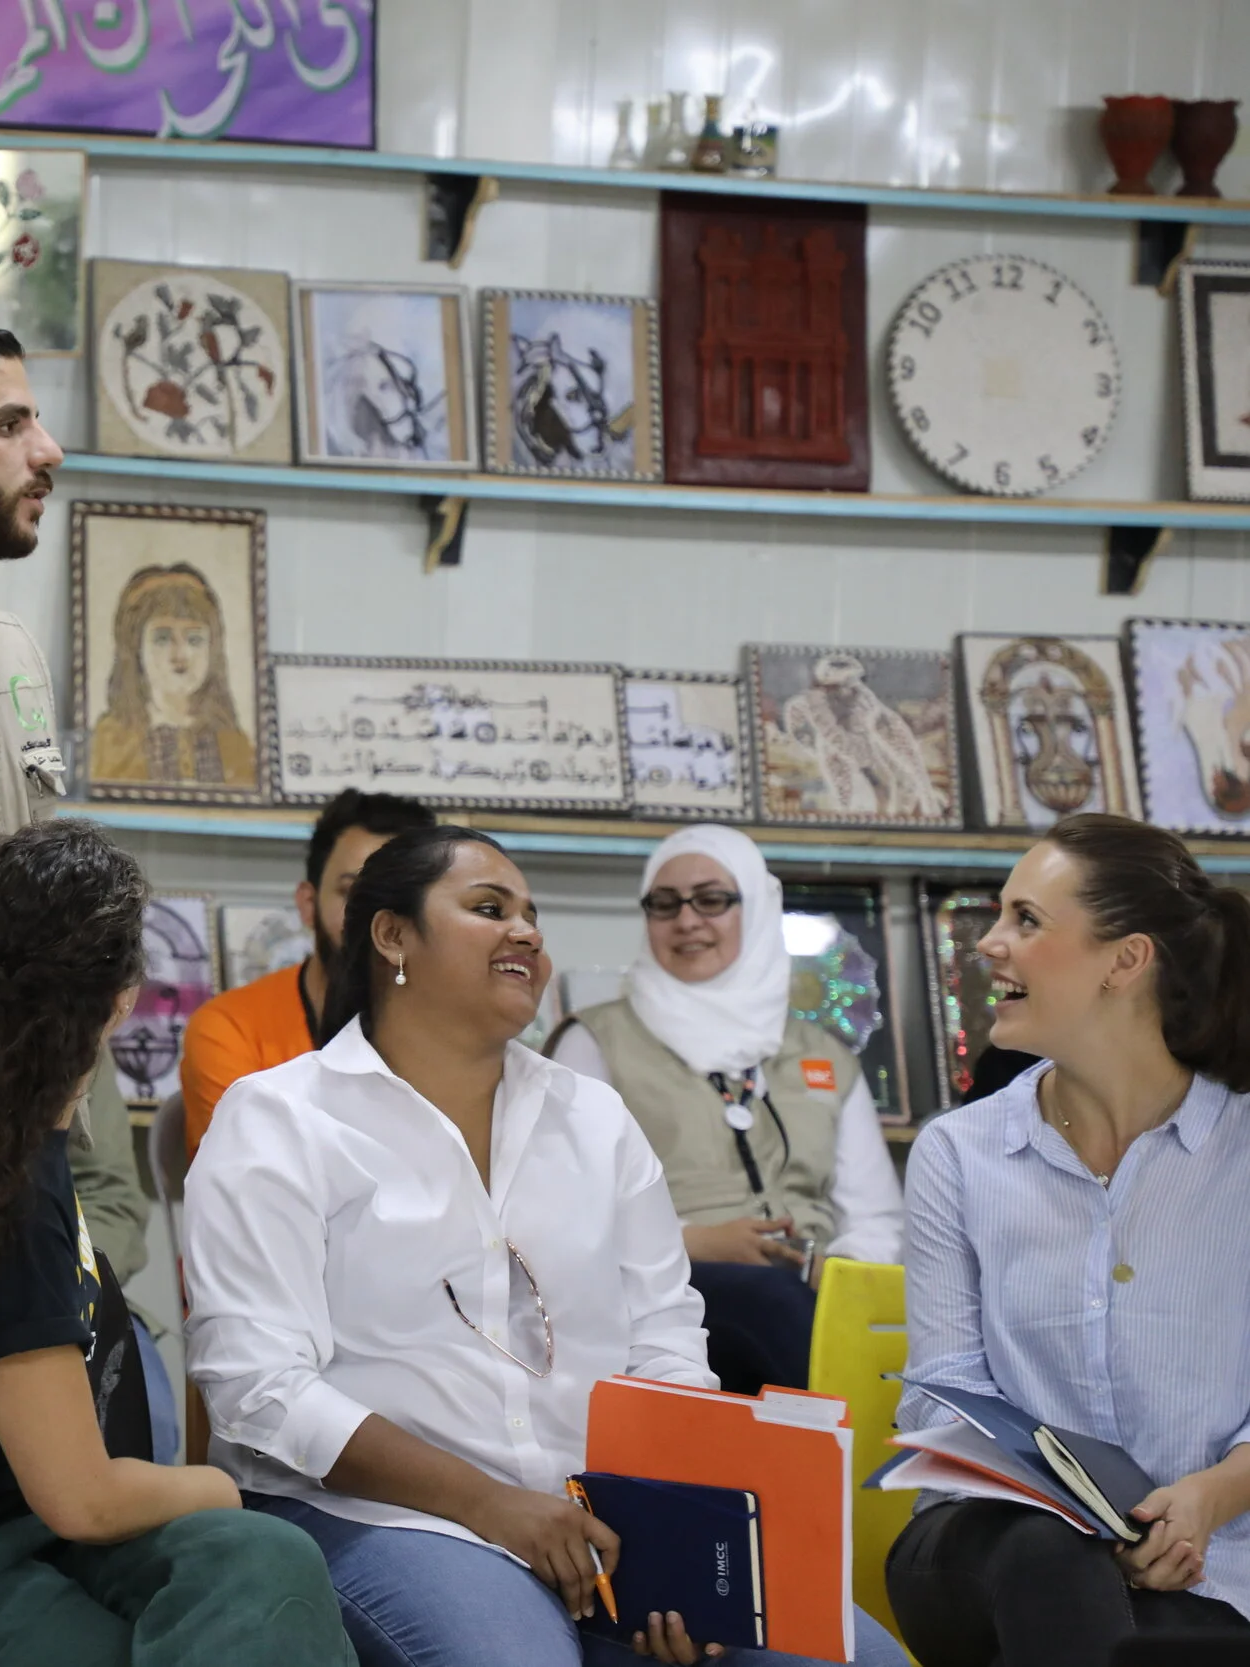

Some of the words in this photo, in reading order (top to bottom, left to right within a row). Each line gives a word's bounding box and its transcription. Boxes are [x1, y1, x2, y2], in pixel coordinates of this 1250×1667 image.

[943, 270, 978, 302] 11
[992, 264, 1024, 291] 12
[1043, 279, 1064, 307] 1
[909, 301, 943, 339] 10
[1083, 318, 1102, 346] 2
[900, 355, 916, 381] 9
[1096, 372, 1113, 398] 3
[910, 406, 931, 432] 8
[1081, 425, 1099, 447] 4
[947, 443, 969, 466] 7
[1038, 454, 1059, 481] 5
[994, 460, 1011, 487] 6
[715, 1542, 726, 1576] IMCC
